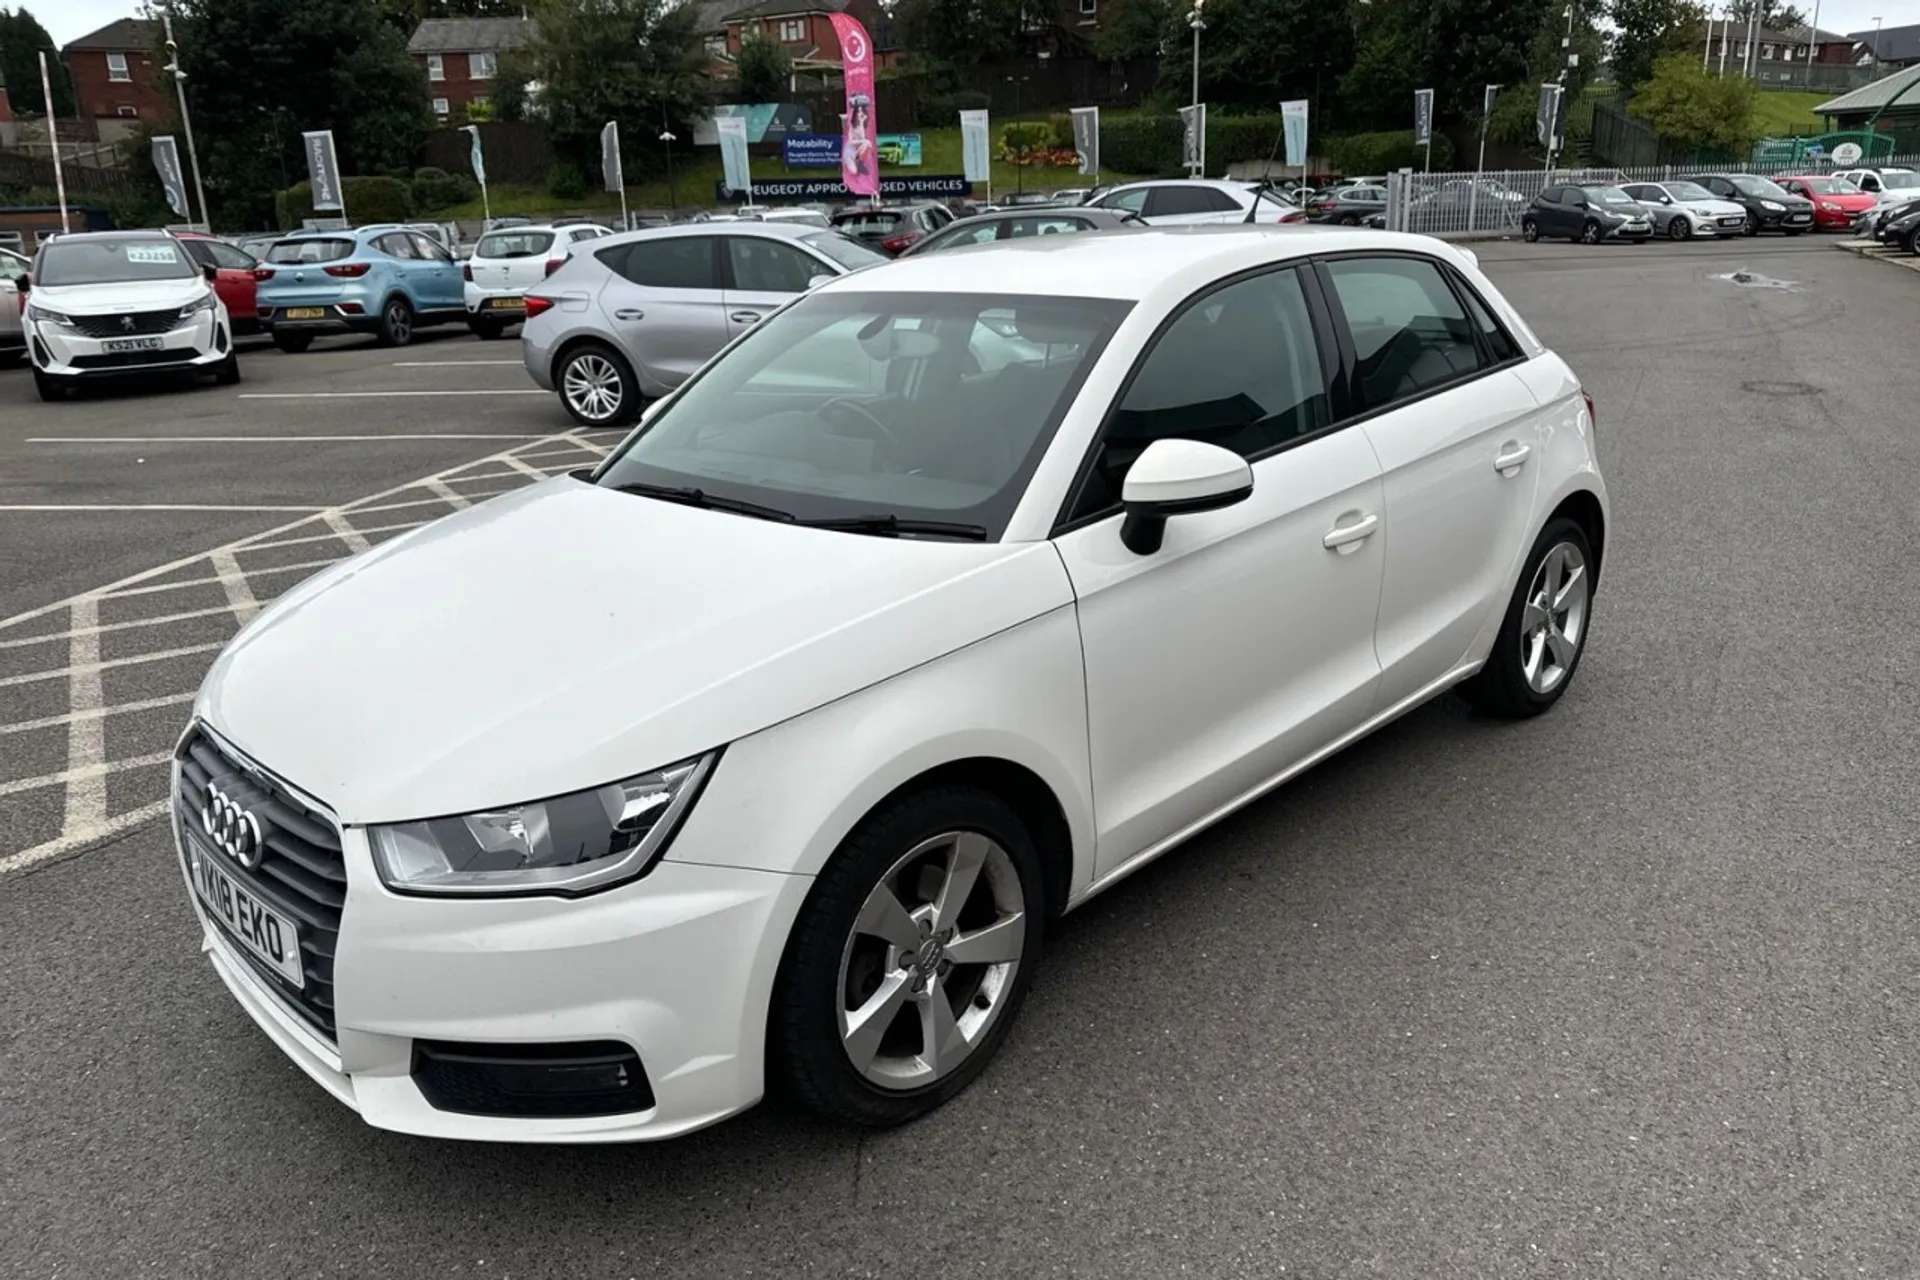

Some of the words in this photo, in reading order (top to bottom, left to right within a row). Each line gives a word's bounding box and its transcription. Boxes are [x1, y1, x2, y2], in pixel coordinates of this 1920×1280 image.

[787, 139, 833, 149] Motability
[907, 180, 963, 191] VEHICLES
[235, 889, 283, 963] EKO
